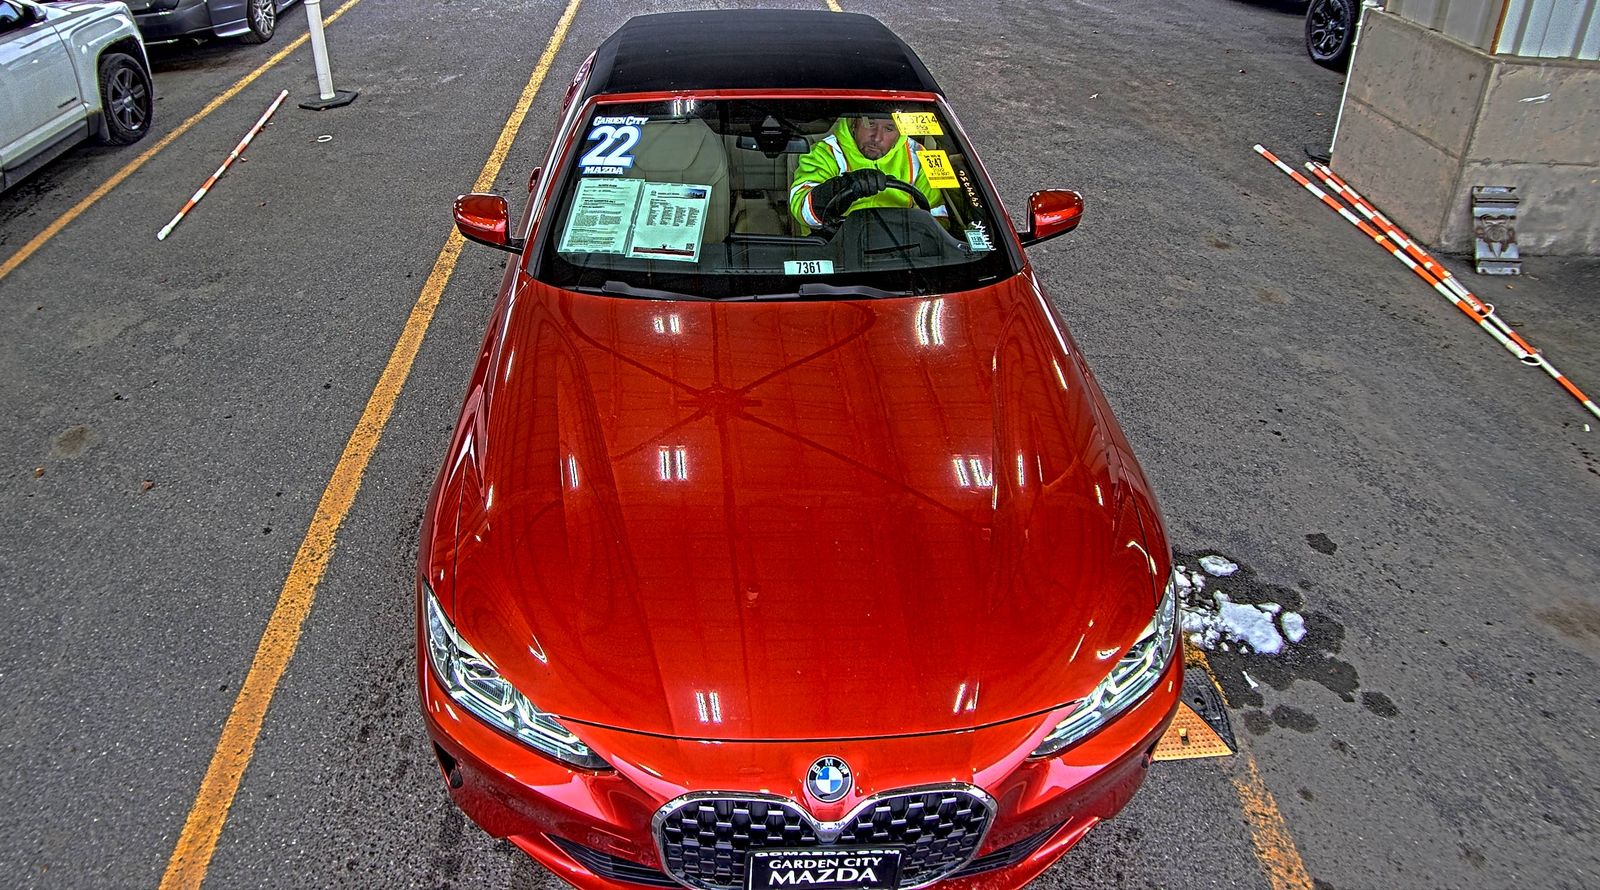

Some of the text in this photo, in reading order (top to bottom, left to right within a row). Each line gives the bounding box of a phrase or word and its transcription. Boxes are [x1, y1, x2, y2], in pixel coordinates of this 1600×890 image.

[593, 116, 649, 126] GARDEN CITY
[579, 125, 641, 167] 22
[926, 158, 943, 168] 3:47
[583, 166, 624, 175] MAZDA
[796, 261, 821, 274] 7361
[811, 758, 849, 775] BMW
[768, 857, 883, 869] GARDEN CITY
[768, 867, 878, 886] MAZDA
